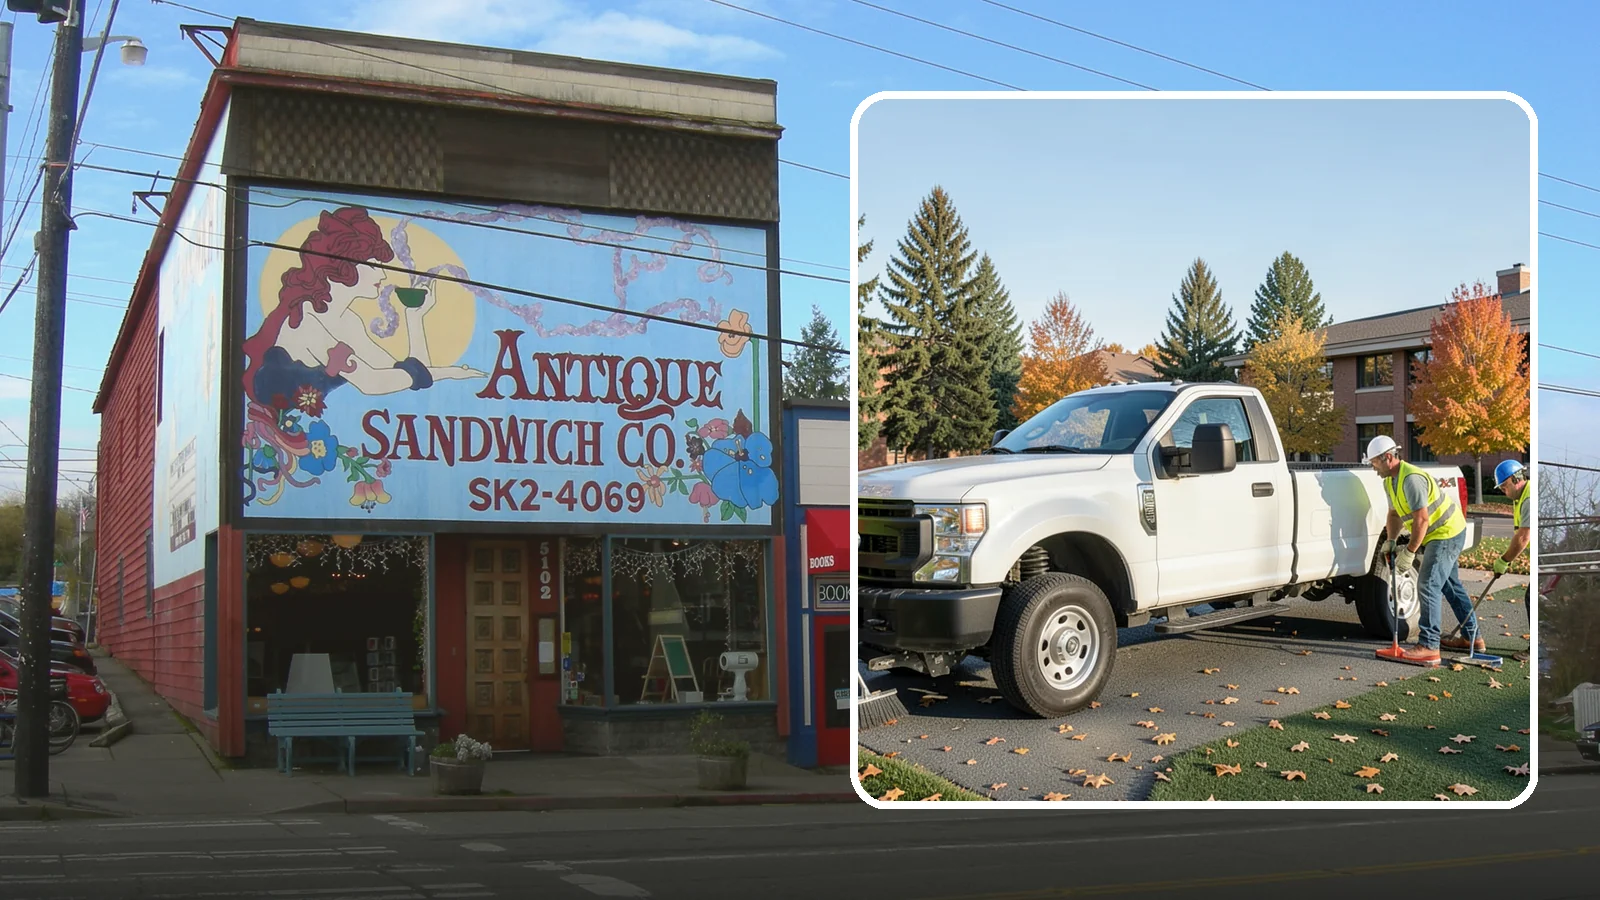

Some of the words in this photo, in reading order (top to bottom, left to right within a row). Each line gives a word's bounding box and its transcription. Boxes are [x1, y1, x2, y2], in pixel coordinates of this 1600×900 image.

[475, 329, 724, 421] ANTIQUE
[361, 408, 604, 468] SANDWICH
[616, 420, 685, 469] CO.
[468, 477, 646, 514] SK2-4069
[539, 541, 552, 600] 5102
[809, 555, 835, 569] BOOKS
